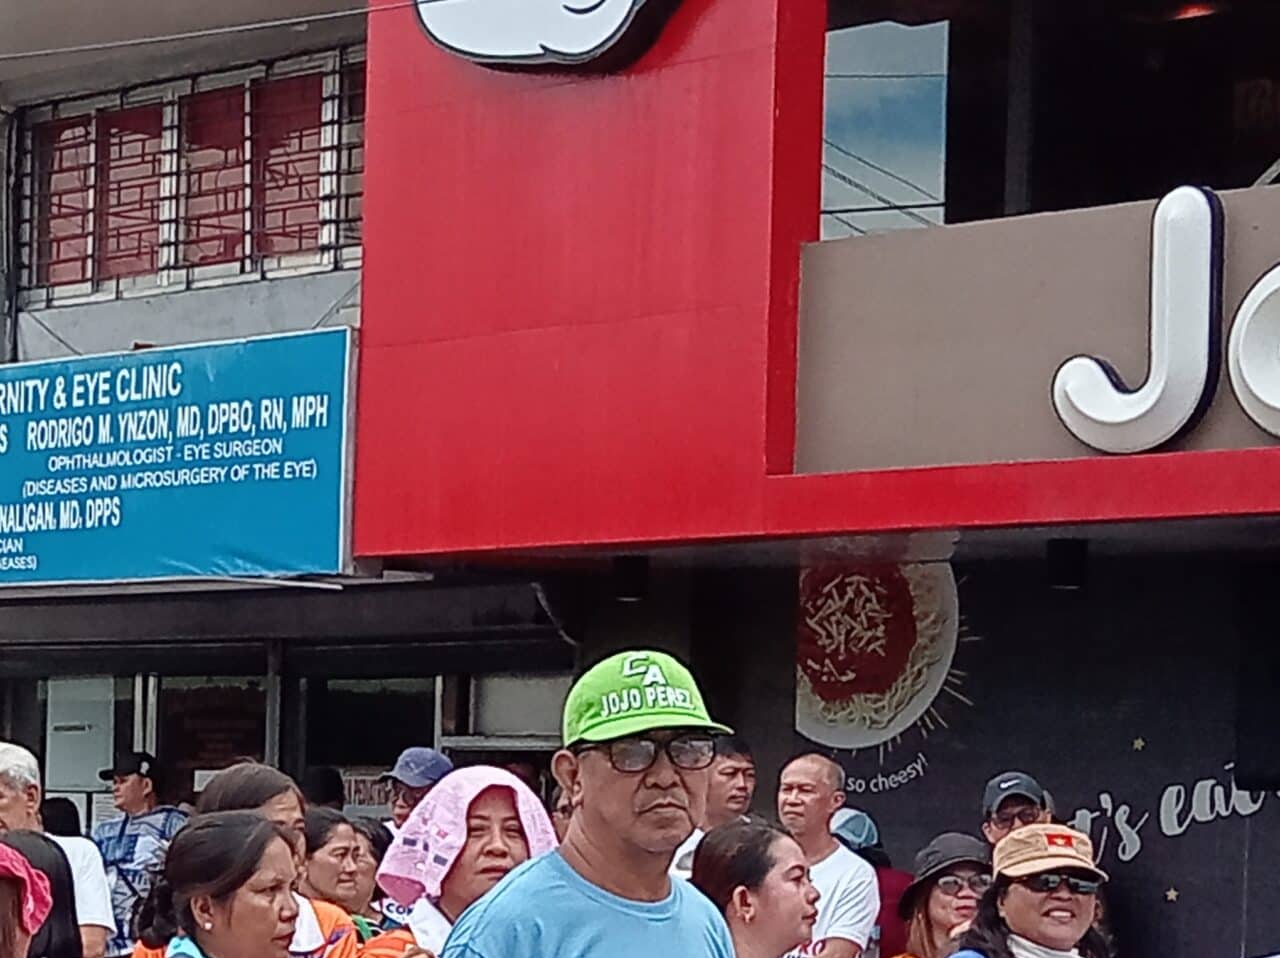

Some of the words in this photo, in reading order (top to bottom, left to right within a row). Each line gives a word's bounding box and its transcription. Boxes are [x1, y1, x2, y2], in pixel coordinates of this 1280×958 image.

[54, 376, 67, 409] &
[72, 371, 111, 407] EYE
[117, 362, 182, 401] CLINIC
[27, 416, 94, 450] RODRIGO
[98, 413, 114, 444] M.
[120, 408, 172, 444] YNZON,
[176, 405, 204, 440] MD,
[208, 401, 256, 437] DPBO,
[260, 399, 287, 433] RN,
[292, 395, 328, 428] MPH
[48, 446, 174, 473] OPHTHALMOLOGIST
[184, 443, 210, 462] EYE
[214, 438, 282, 459] SURGEON
[22, 478, 87, 499] (DISEASES
[90, 474, 117, 493] AND
[121, 467, 227, 490] MICROSURGERY
[231, 464, 250, 482] OF
[253, 462, 280, 480] THE
[284, 458, 318, 479] EYE)
[86, 497, 120, 527] DPPS
[601, 688, 641, 717] JOJO
[846, 777, 866, 793] so
[869, 752, 929, 792] cheesy!
